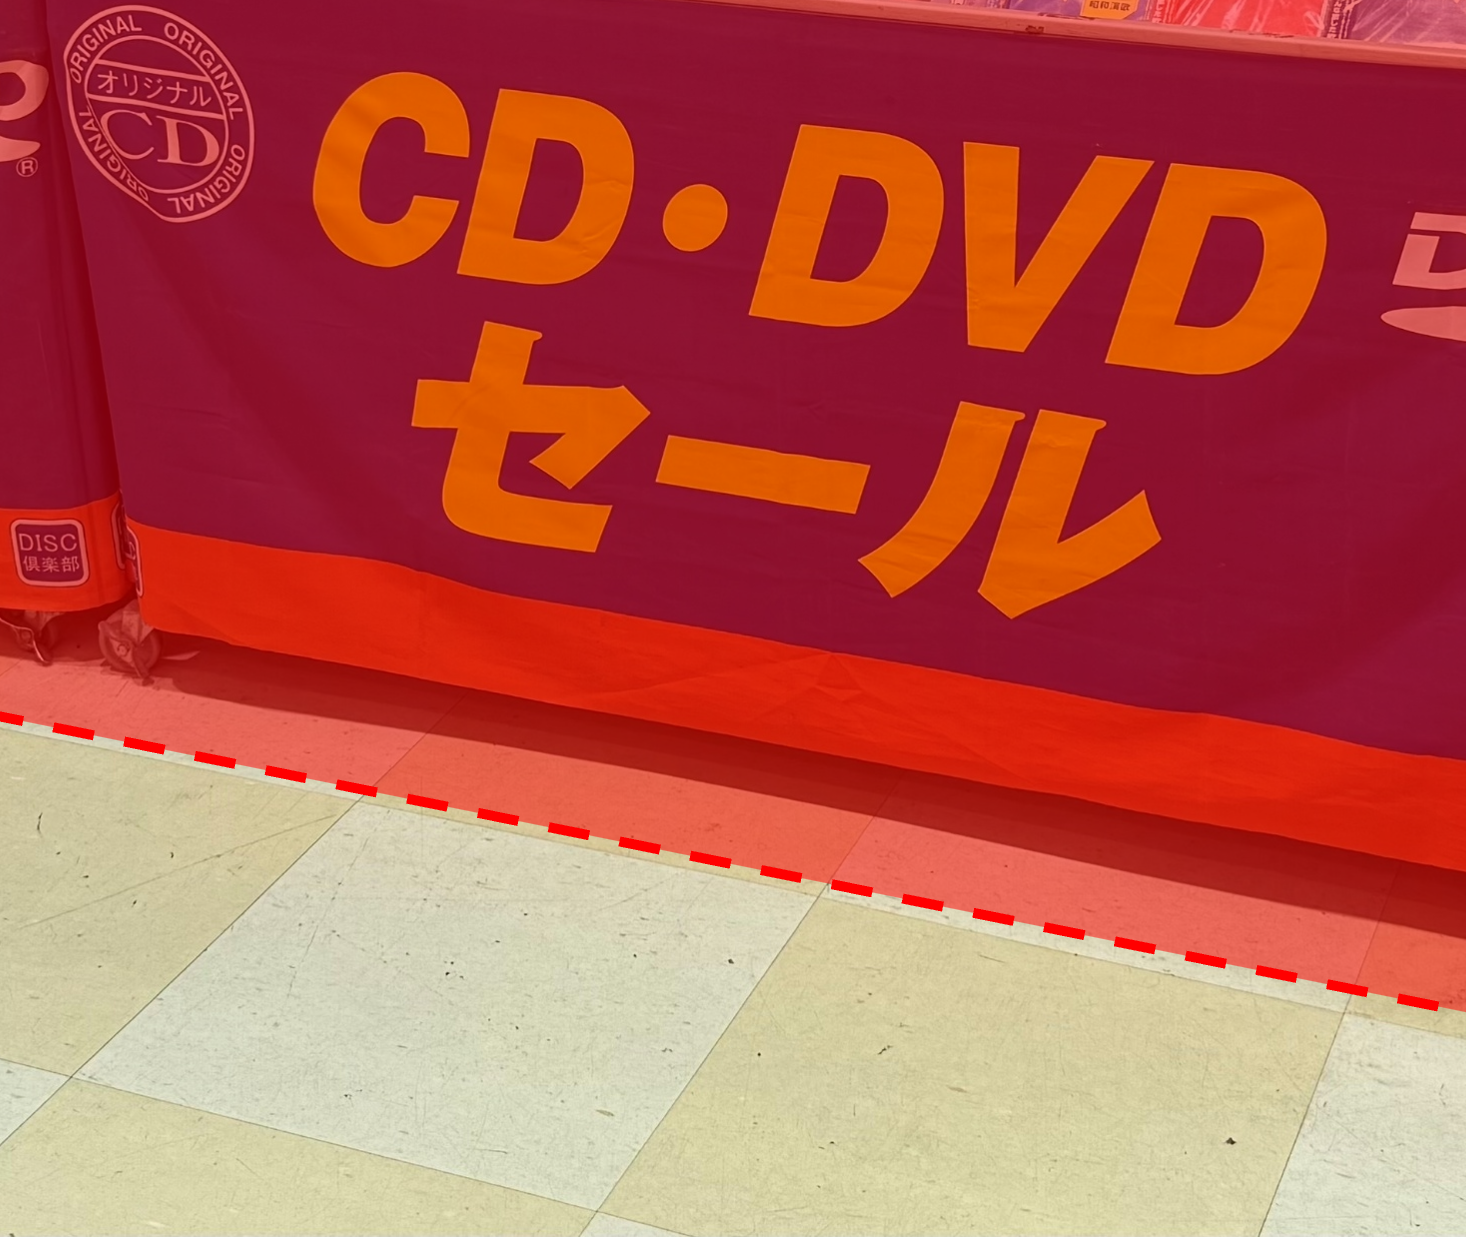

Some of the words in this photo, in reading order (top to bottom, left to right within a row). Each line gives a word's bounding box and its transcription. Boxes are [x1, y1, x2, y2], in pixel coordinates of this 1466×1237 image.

[94, 66, 214, 108] オリジナル
[100, 106, 222, 167] CD
[410, 320, 1163, 620] セール
[18, 532, 78, 552] DISC
